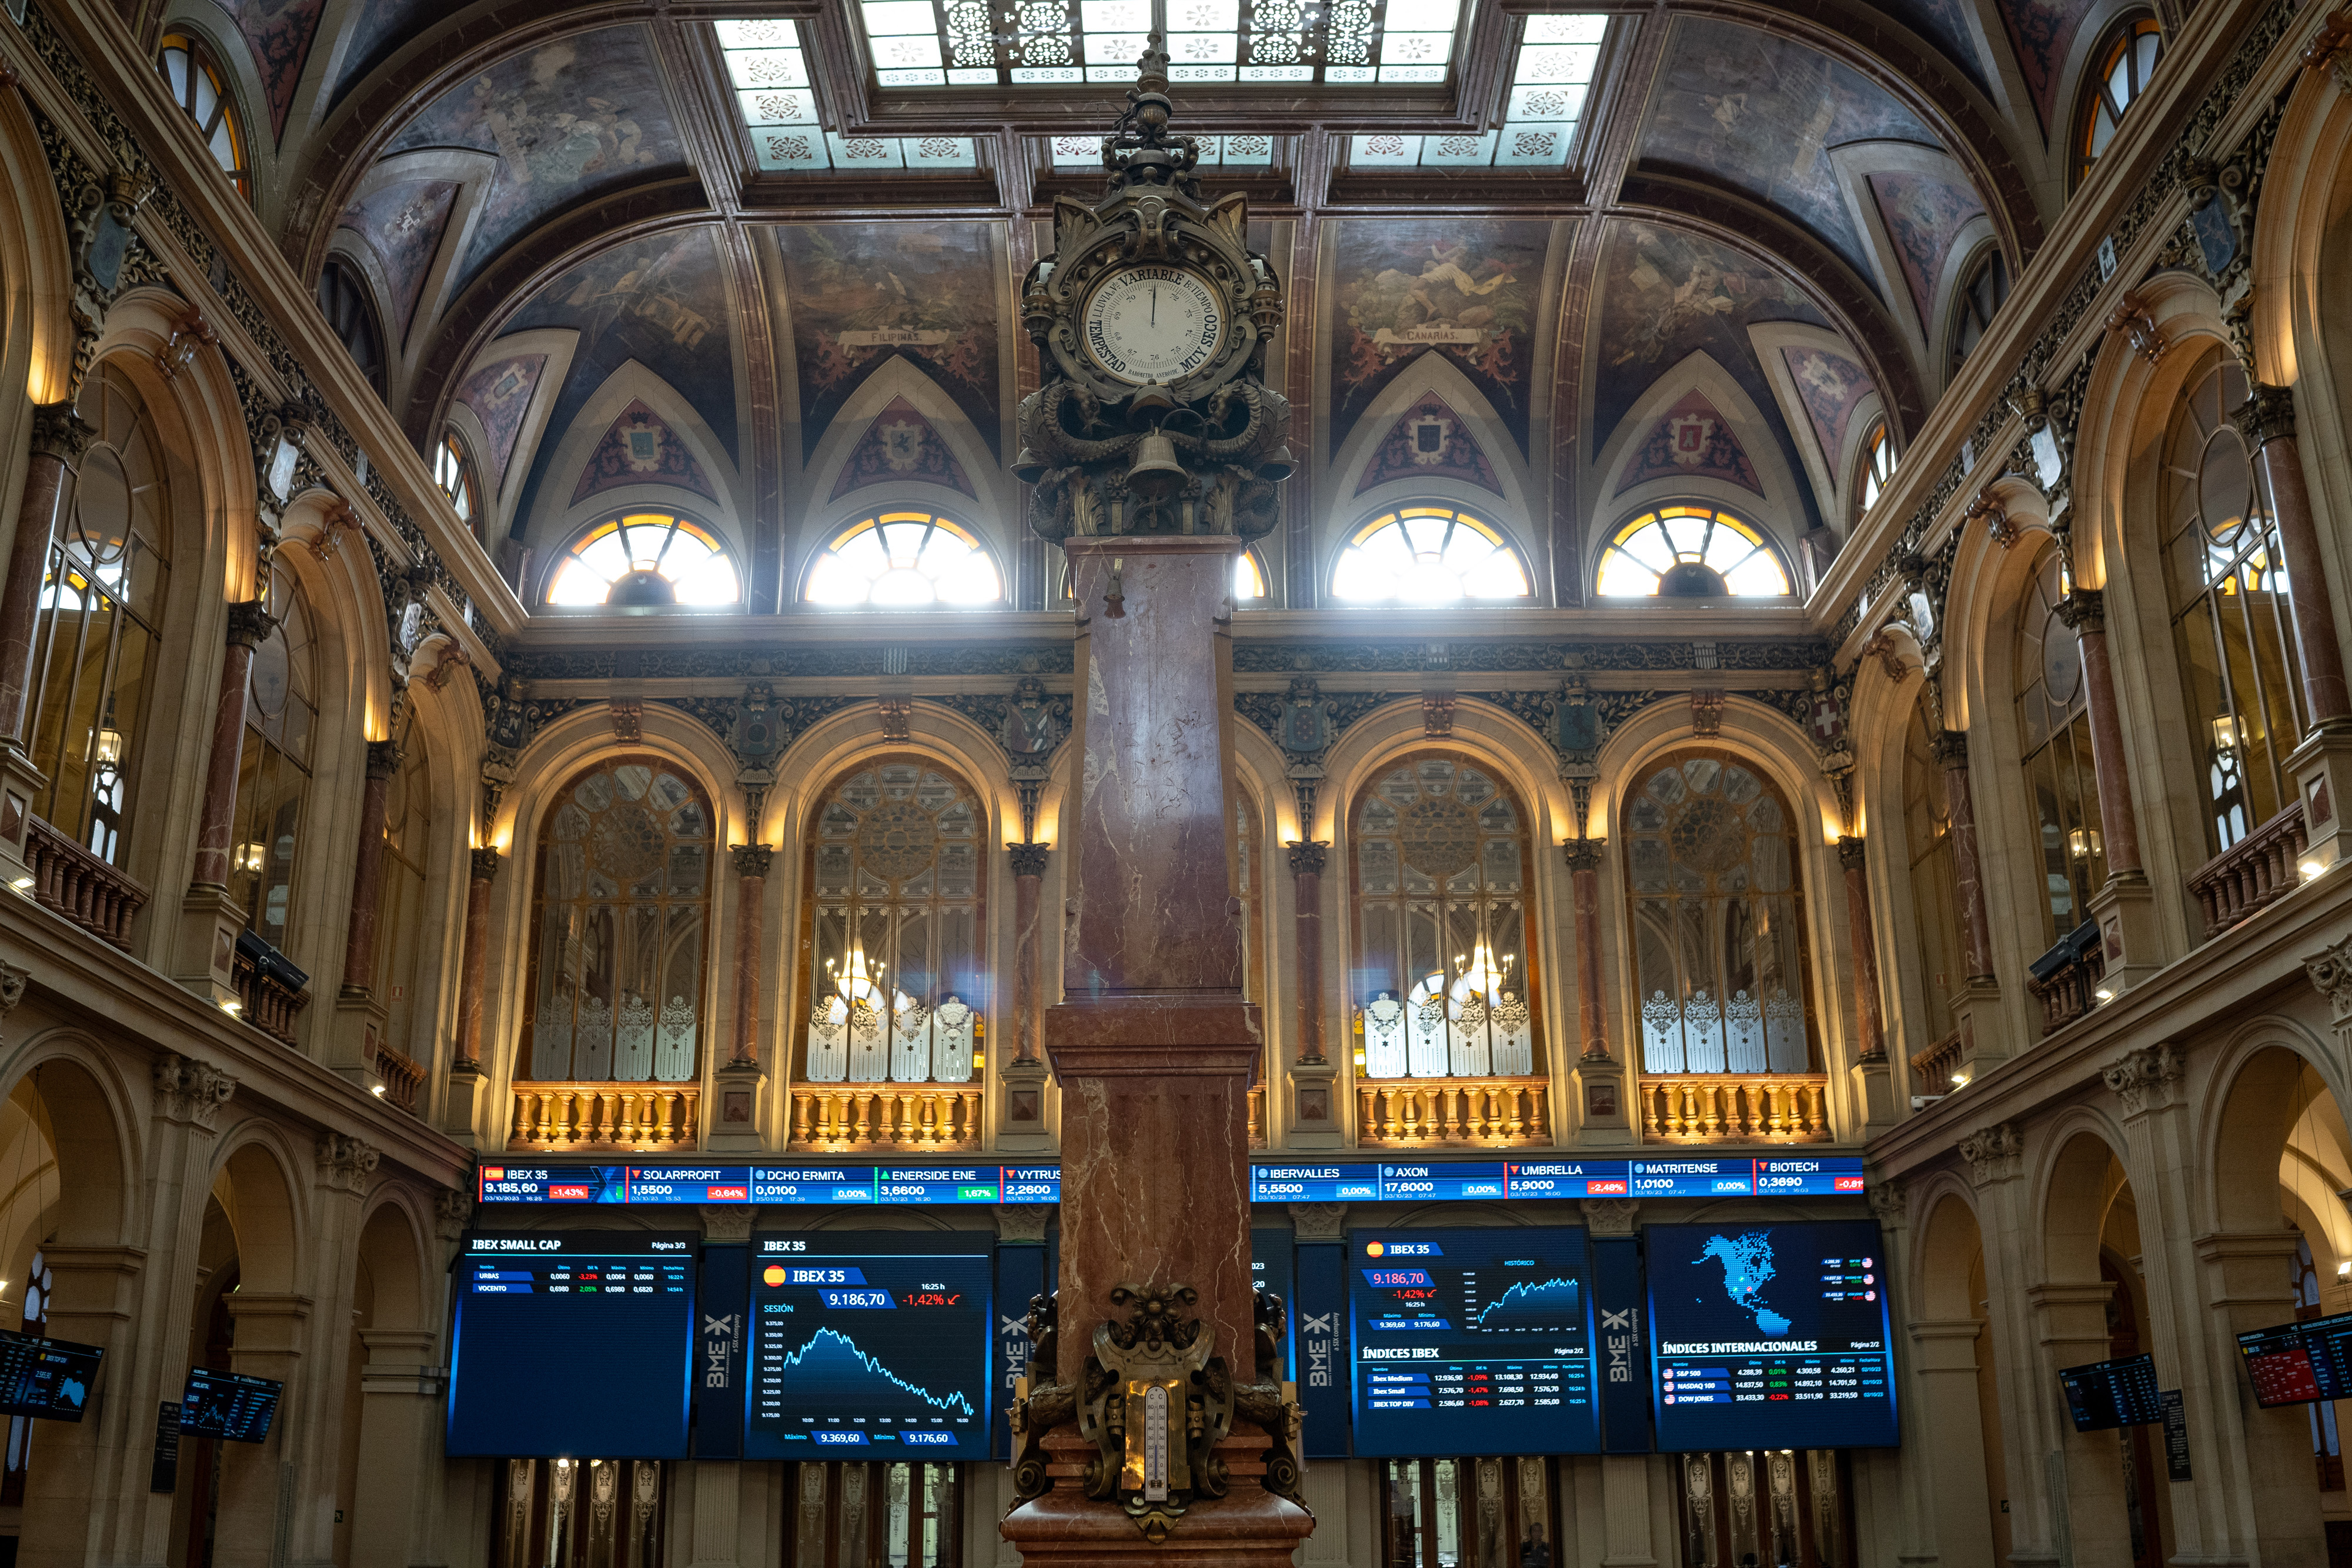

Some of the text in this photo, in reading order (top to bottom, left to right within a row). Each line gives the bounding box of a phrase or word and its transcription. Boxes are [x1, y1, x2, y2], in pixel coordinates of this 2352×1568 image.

[1118, 269, 1184, 286] VARIABLE
[1126, 295, 1135, 303] 70
[1169, 293, 1180, 302] 72
[1191, 285, 1213, 313] TIEMPO
[1093, 291, 1112, 317] LLUVIA
[871, 332, 922, 342] FILIPINAS.
[1114, 332, 1122, 341] 68
[1407, 331, 1458, 340] CANARIAS.
[1090, 320, 1126, 373] TEMPESTAD
[1179, 315, 1217, 373] MUY SECO
[1171, 346, 1181, 354] 75
[1564, 767, 1595, 775] HOLANDA
[743, 773, 771, 781] TURQUIA
[1522, 1165, 1583, 1175] UMBRELLA
[1646, 1164, 1718, 1174] MATRITENSE
[1770, 1162, 1819, 1172] BIOTECH
[507, 1170, 547, 1179] IBEX 35
[643, 1171, 721, 1180] SOLARPROFIT
[767, 1171, 846, 1181] DCHO ERMITA
[892, 1171, 976, 1181] ENERSIDE ENE
[1017, 1170, 1061, 1179] VYTRUS
[1271, 1168, 1339, 1178] IBERVALLES
[1396, 1168, 1428, 1177] AXON
[1385, 1182, 1434, 1193] 17,6000
[1510, 1181, 1554, 1191] 5,9000
[1591, 1183, 1623, 1192] -2,48%
[1635, 1179, 1673, 1189] 1,0100
[1717, 1182, 1745, 1190] 0,00%
[1759, 1177, 1802, 1188] 0,3690
[1839, 1180, 1863, 1188] -0,81
[485, 1183, 538, 1193] 9.185,60
[553, 1188, 584, 1197] -1,43%
[632, 1185, 673, 1196] 1,5500
[755, 1185, 797, 1196] 0,0100
[880, 1185, 925, 1196] 3,6600
[1006, 1185, 1051, 1196] 2,2600
[1258, 1183, 1303, 1195] 5,5500
[1342, 1187, 1371, 1195] 0,00%
[711, 1189, 744, 1198] -0,64%
[838, 1190, 867, 1198] 0,00%
[964, 1189, 991, 1198] 1,67%
[472, 1239, 561, 1250] IBEX SMALL CAP
[652, 1242, 674, 1250] Página
[764, 1241, 806, 1251] IBEX 35
[1390, 1245, 1429, 1254] IBEX 35
[793, 1271, 845, 1282] IBEX 35
[1374, 1273, 1424, 1285] 9.186,70
[1393, 1289, 1424, 1299] -1,42%
[829, 1293, 885, 1306] 9.186,70
[903, 1294, 944, 1306] -1,42%
[764, 1303, 794, 1312] SESIÓN
[1662, 1340, 1817, 1354] ÍNDICES INTERNACIONALES
[1362, 1346, 1439, 1359] ÍNDICES IBEX
[1308, 1340, 1327, 1386] BME
[1608, 1335, 1628, 1382] BME
[707, 1341, 726, 1388] BME
[821, 1434, 860, 1443] 9.369,60
[910, 1434, 948, 1443] 9.176,60
